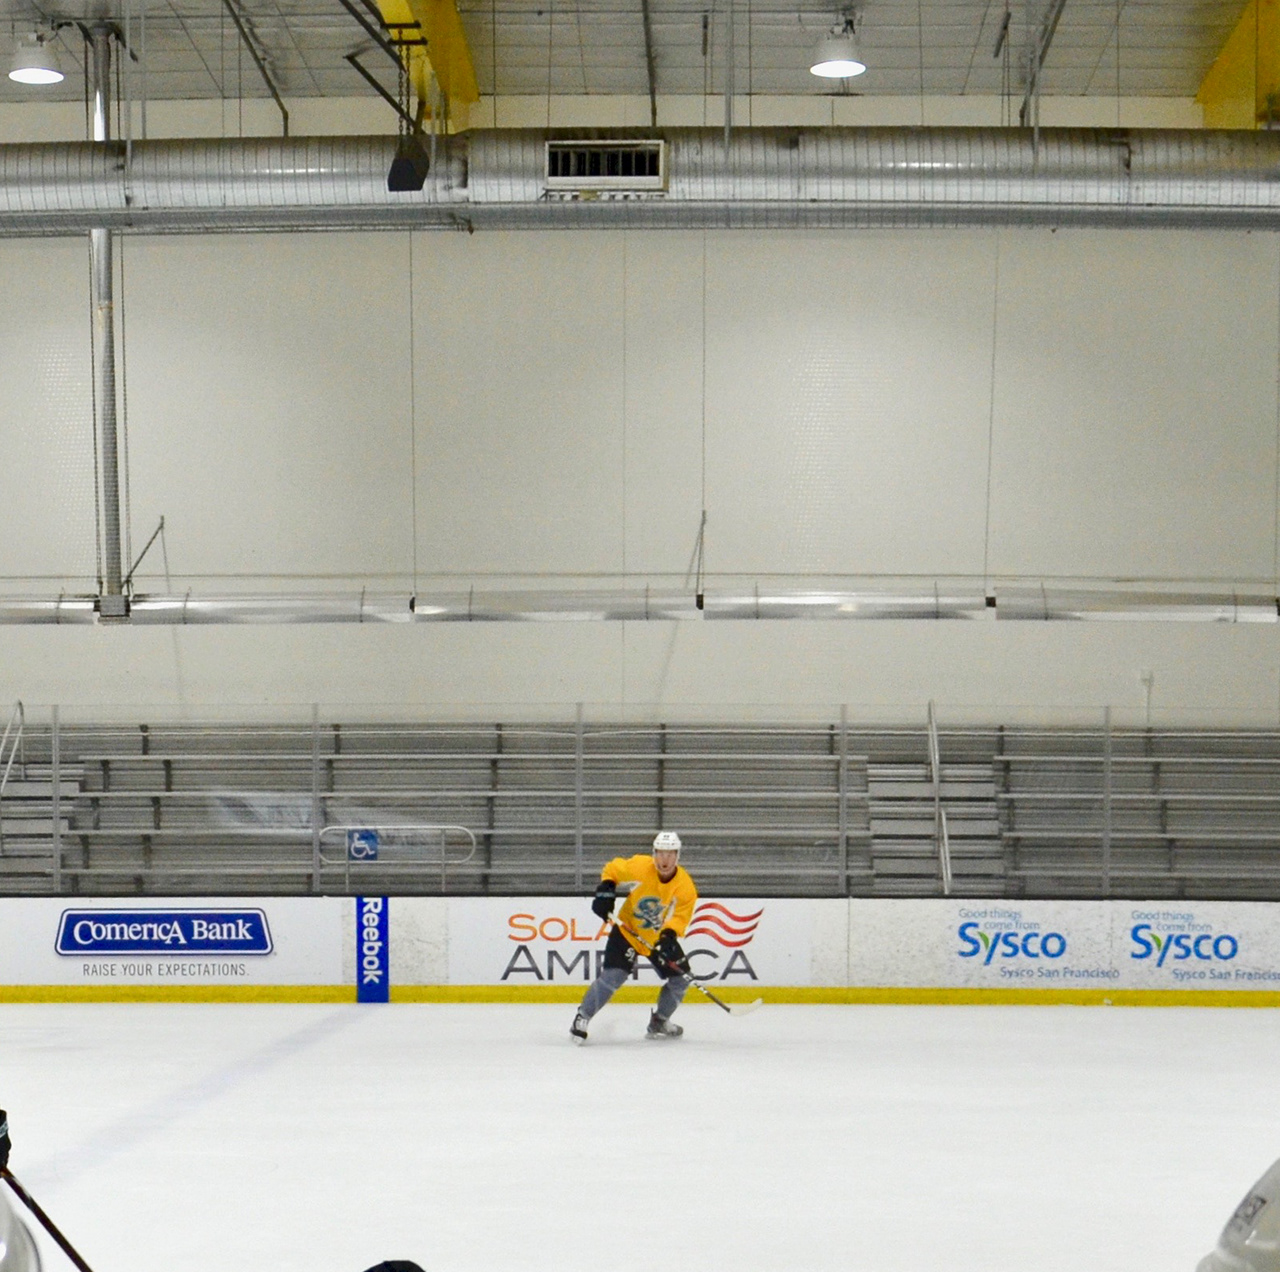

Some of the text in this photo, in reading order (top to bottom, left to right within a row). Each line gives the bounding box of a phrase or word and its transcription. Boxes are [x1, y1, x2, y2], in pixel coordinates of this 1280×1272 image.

[959, 908, 1022, 920] Good things
[1131, 911, 1194, 922] Good things
[192, 919, 253, 940] Bank
[508, 913, 615, 942] SOLA
[984, 922, 1012, 930] come
[362, 897, 382, 984] Reebok
[501, 945, 758, 980] AMCA
[83, 963, 250, 976] RAISE YOUR EXPECTATIONS.
[1000, 966, 1120, 979] Sysco San Francisco
[1172, 968, 1206, 981] Sysco
[1209, 968, 1232, 980] San
